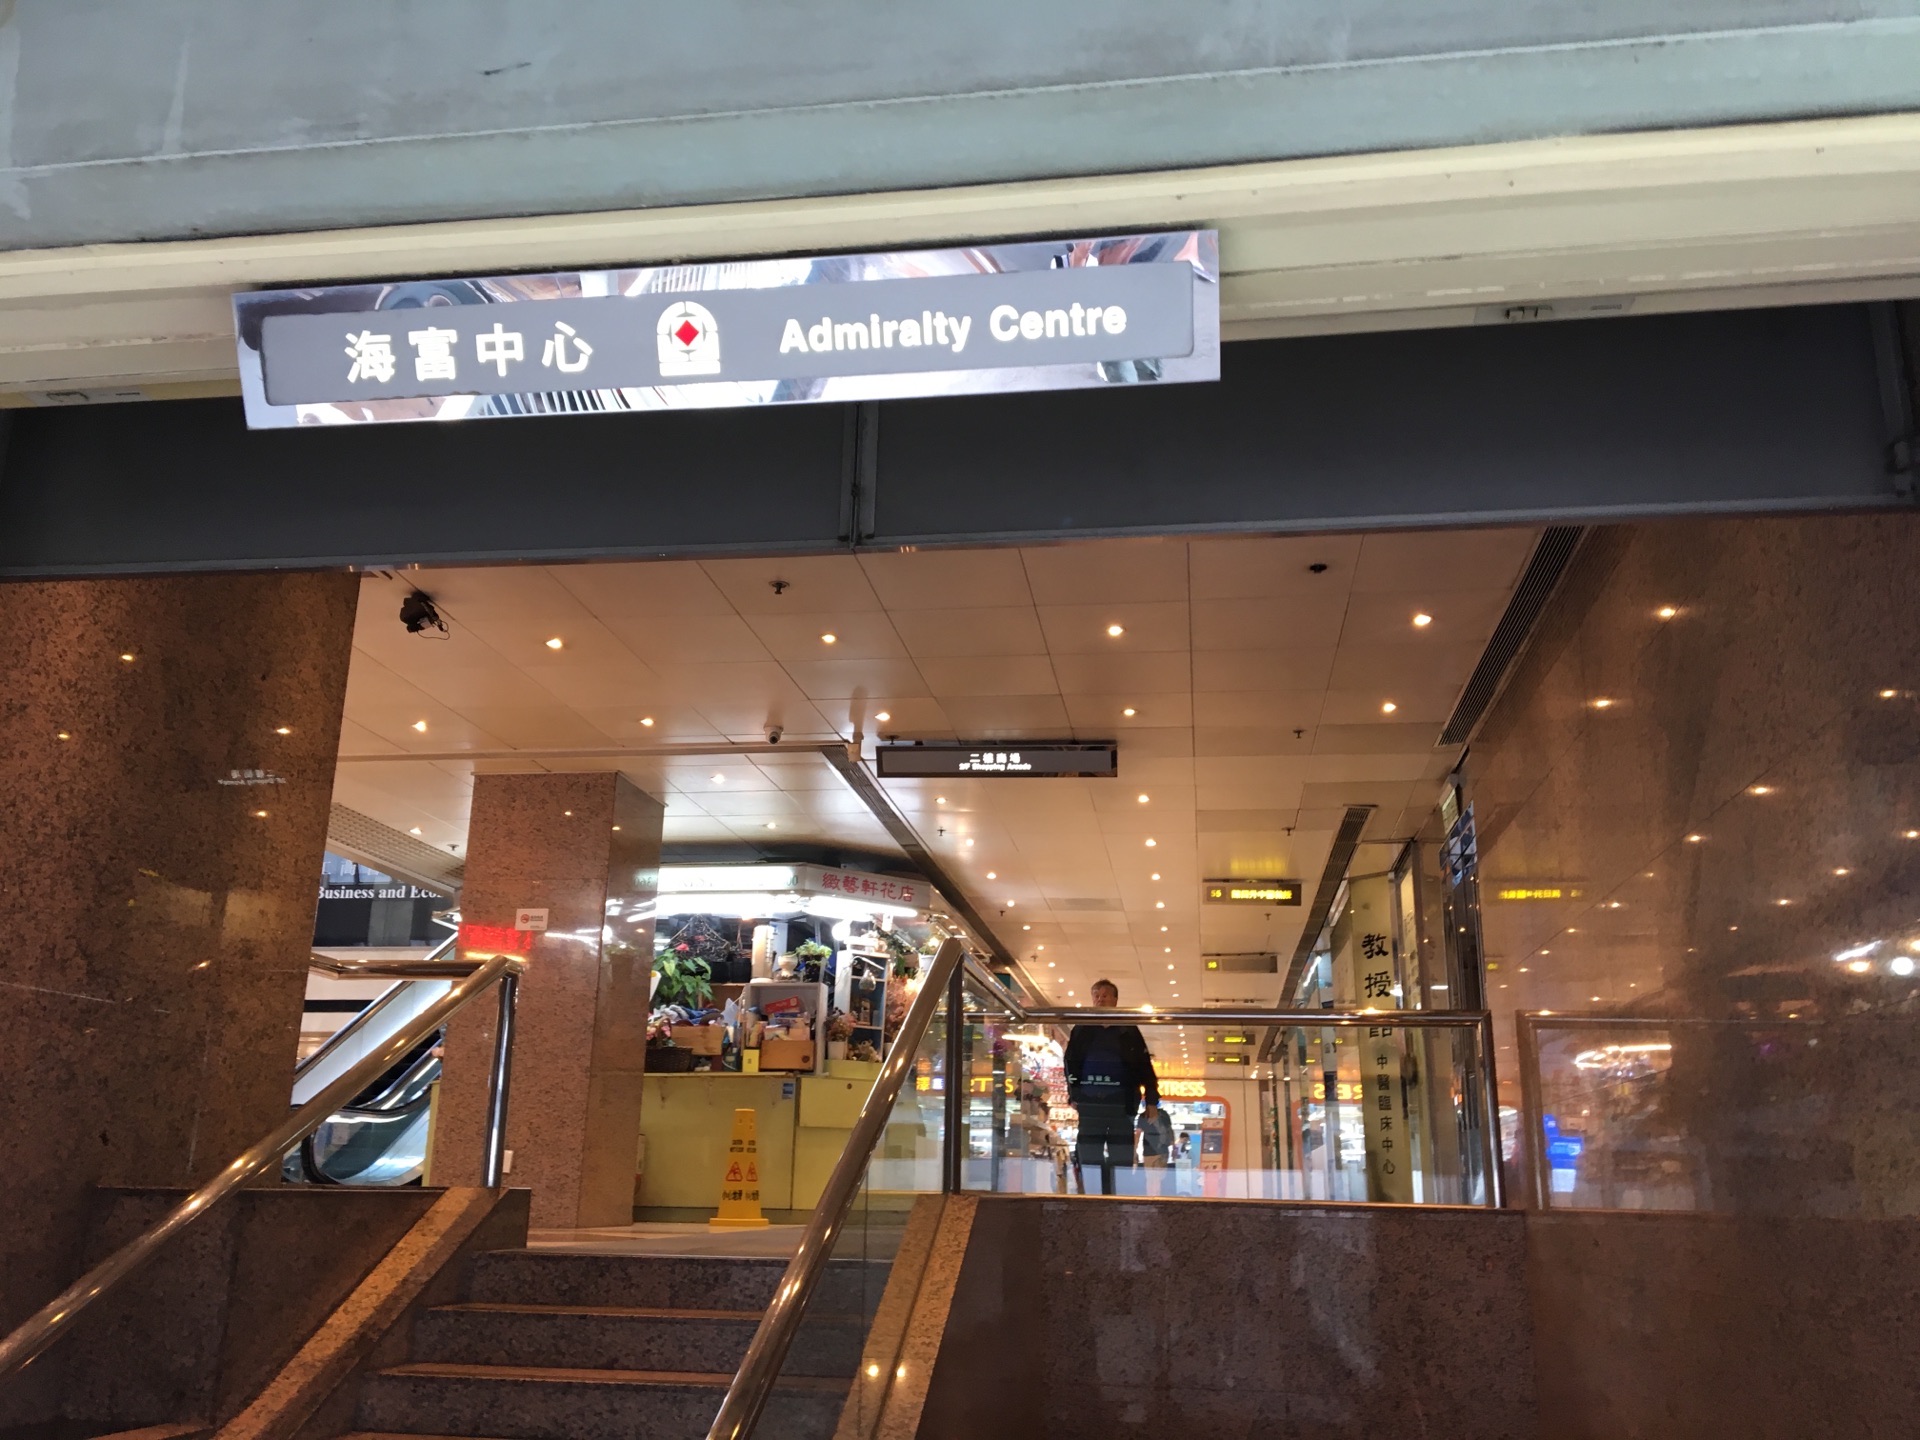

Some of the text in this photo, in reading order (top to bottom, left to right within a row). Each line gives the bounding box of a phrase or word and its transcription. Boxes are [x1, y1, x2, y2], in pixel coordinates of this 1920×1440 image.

[345, 320, 593, 383] 海富中心
[780, 303, 1127, 352] Admiralty Centre
[378, 886, 405, 898] and
